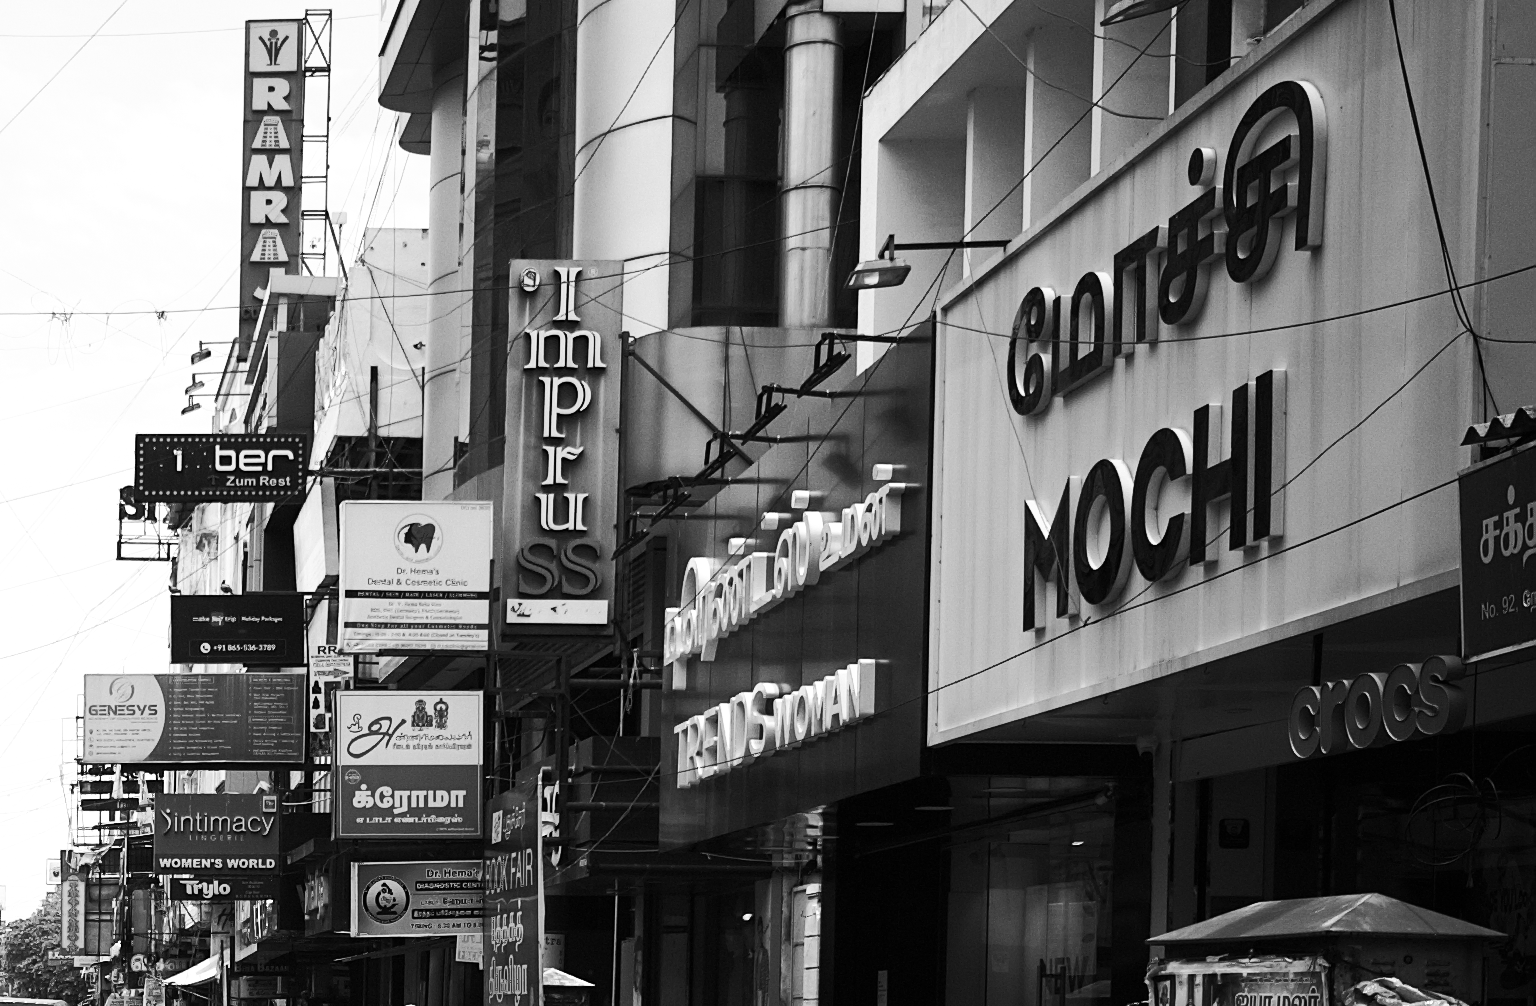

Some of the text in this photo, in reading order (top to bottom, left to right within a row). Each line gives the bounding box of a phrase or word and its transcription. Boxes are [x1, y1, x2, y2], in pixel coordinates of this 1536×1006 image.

[1007, 80, 1327, 416] மோச்சி
[226, 475, 291, 487] Zum Rest
[1021, 367, 1288, 634] MOCHI
[1481, 601, 1499, 621] No.
[1502, 593, 1519, 615] 92,
[88, 704, 158, 716] GENESYS
[1288, 655, 1462, 760] crocs
[352, 783, 467, 815] க்ரோமா
[159, 857, 276, 869] WOMEN'S WORLD
[510, 848, 534, 890] FAIR
[179, 879, 231, 899] Trylo
